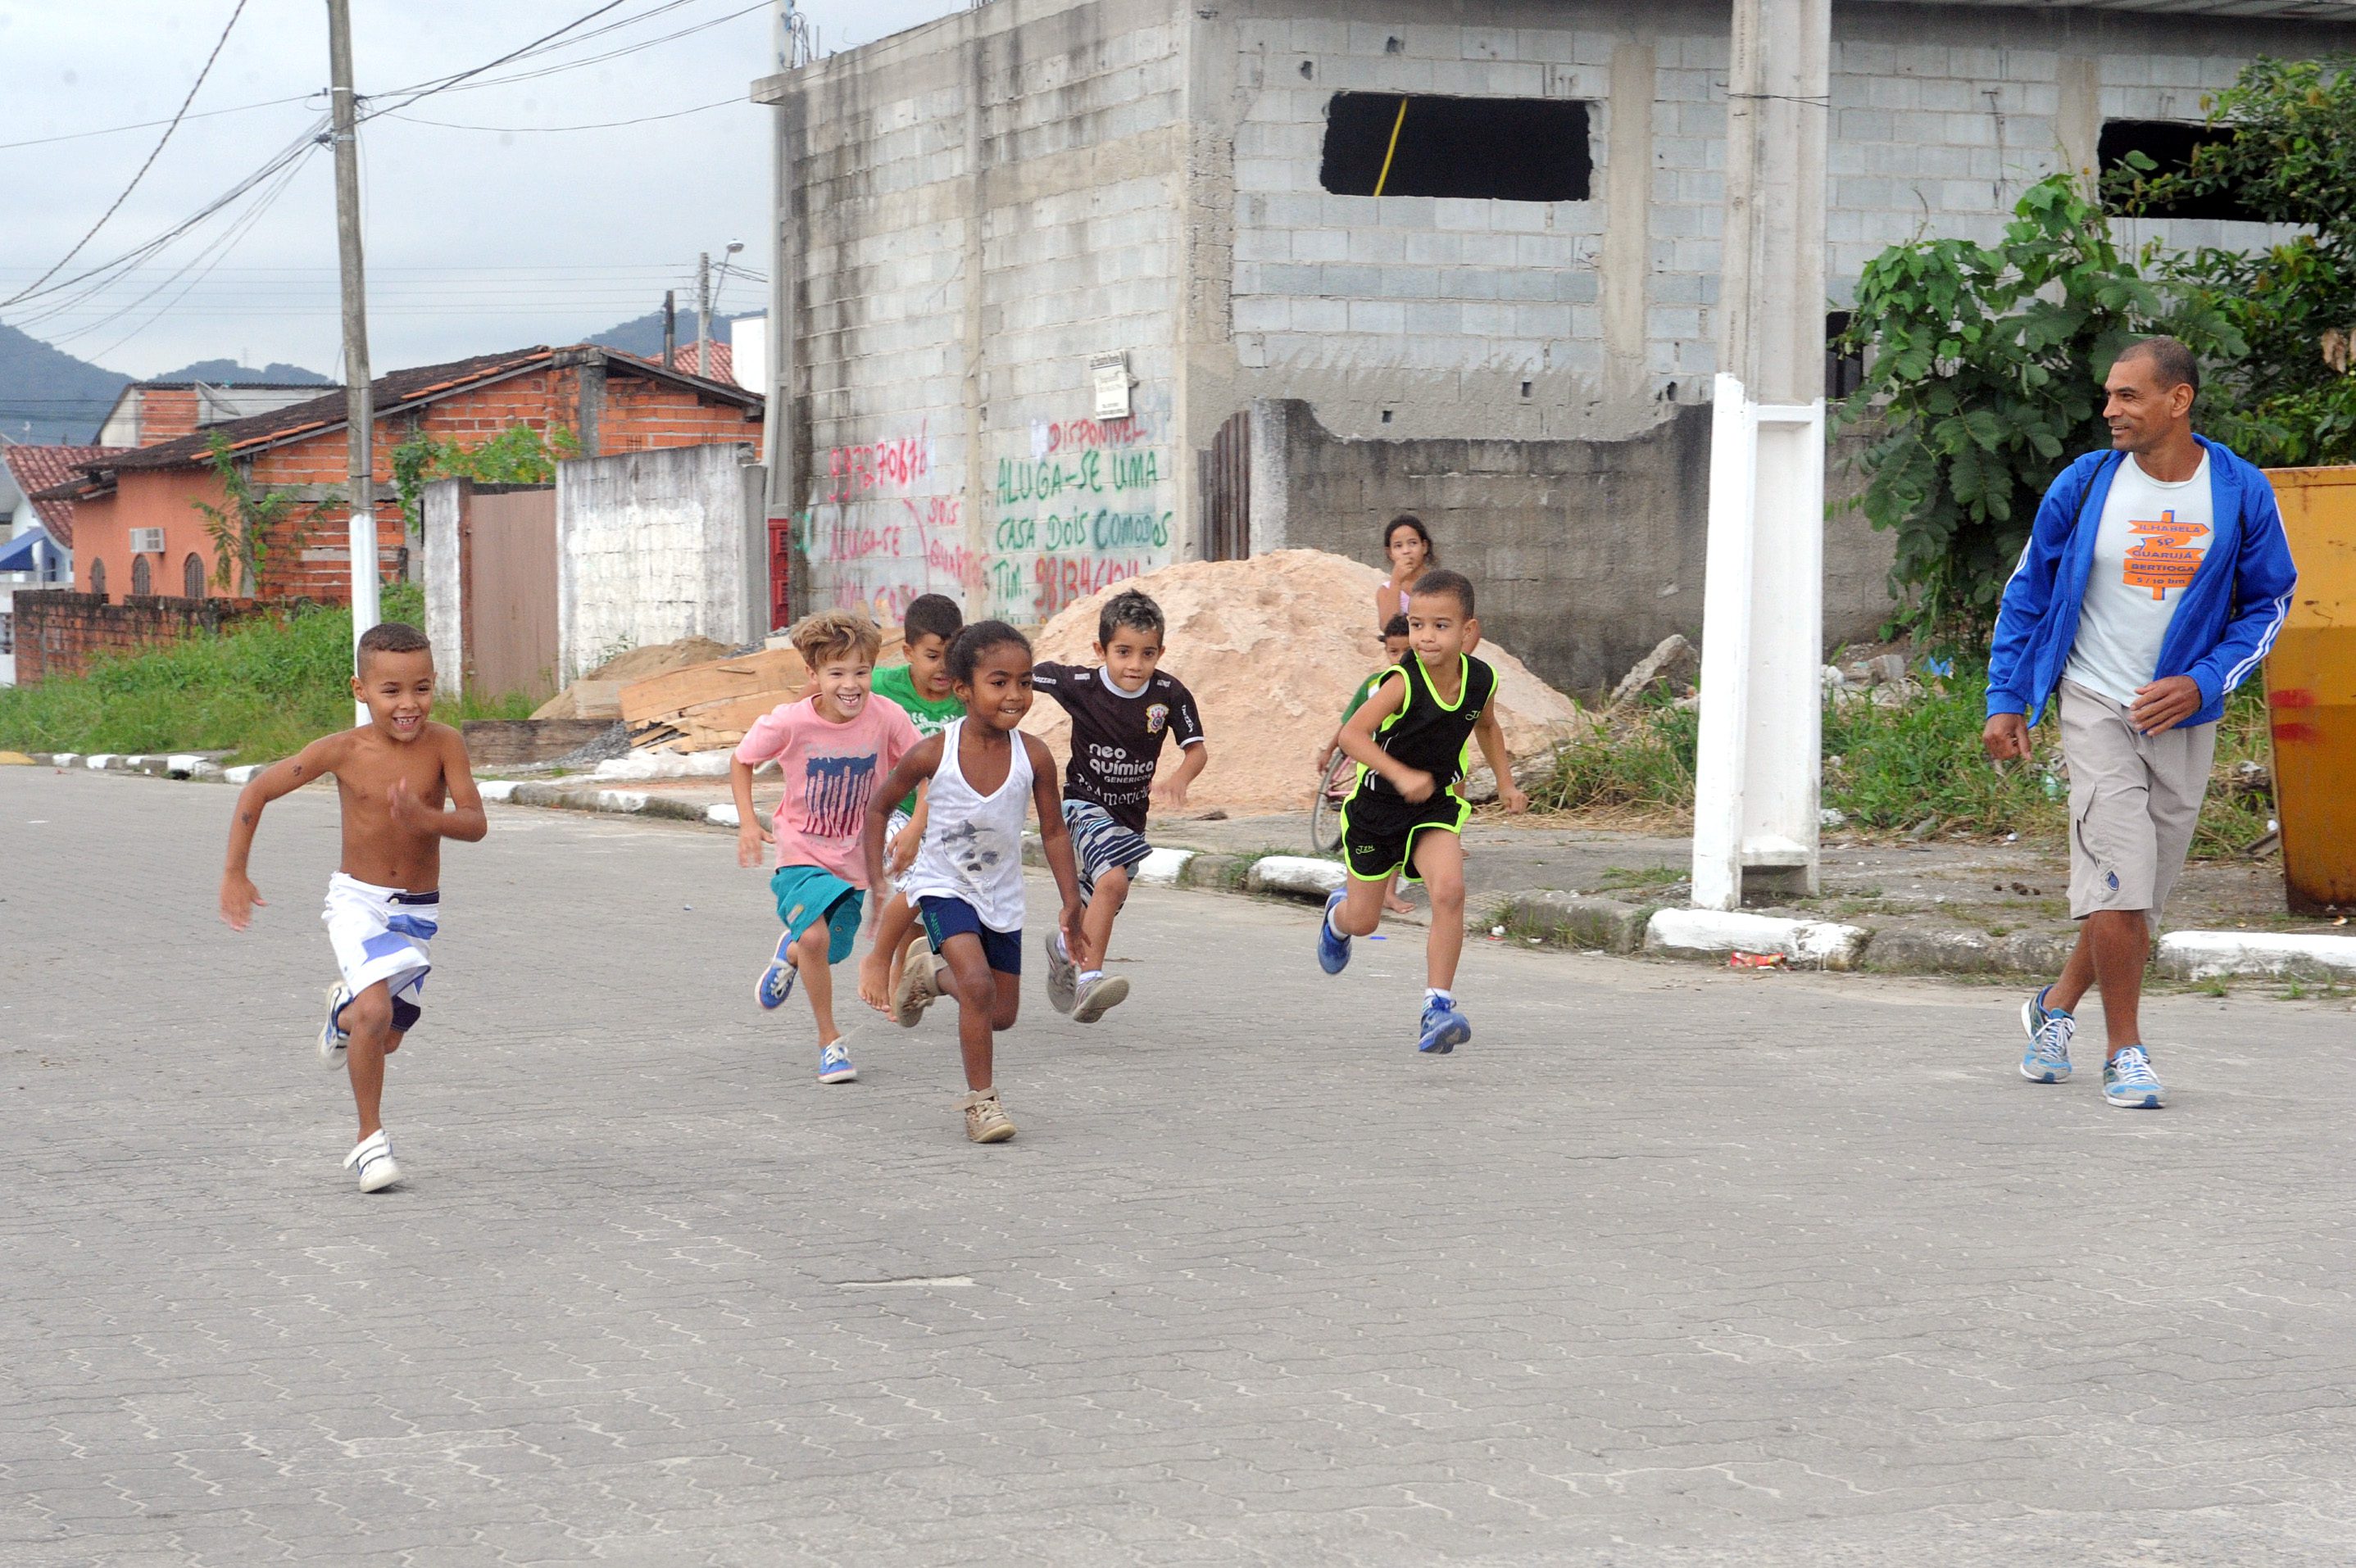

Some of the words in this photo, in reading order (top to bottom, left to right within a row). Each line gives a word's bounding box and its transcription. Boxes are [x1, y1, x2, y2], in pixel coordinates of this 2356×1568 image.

[996, 449, 1101, 506] ALUGA-SE
[1113, 451, 1156, 490] UMA
[996, 517, 1035, 551] CASA
[2156, 537, 2174, 546] SP
[2131, 564, 2195, 572] BERTIOGA
[1089, 743, 1127, 759] neo
